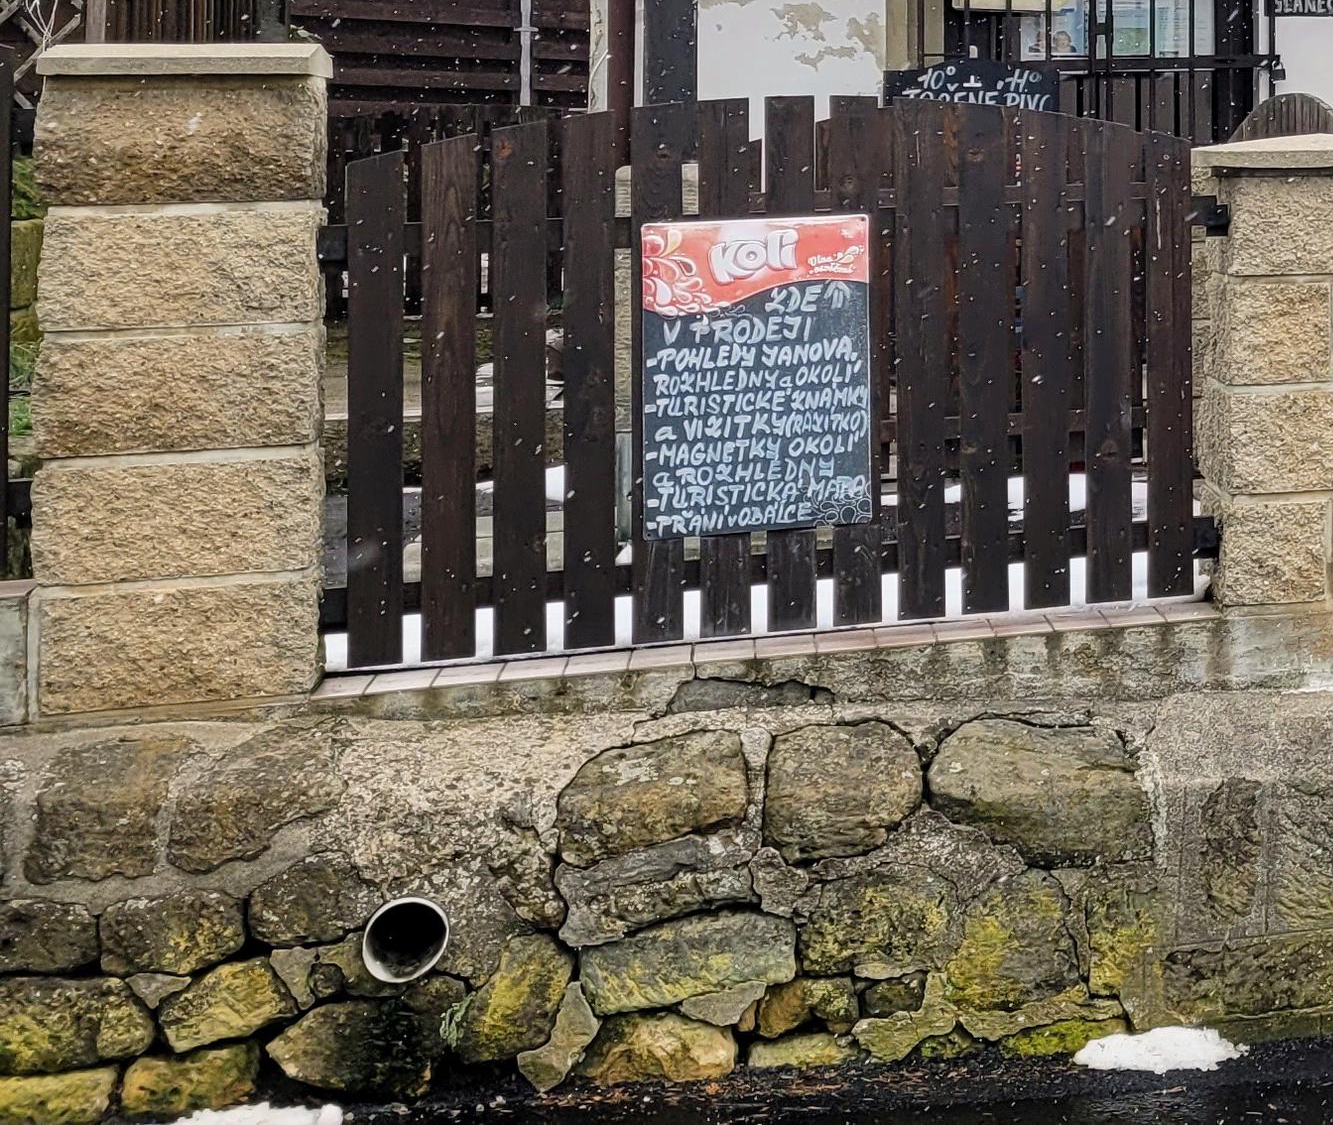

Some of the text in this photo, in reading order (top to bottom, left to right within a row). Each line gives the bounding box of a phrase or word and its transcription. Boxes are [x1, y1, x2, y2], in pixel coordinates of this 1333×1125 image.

[765, 284, 822, 313] ZDE
[663, 320, 681, 346] V
[653, 368, 776, 396] ROZHLEDNY
[655, 426, 678, 442] a
[683, 412, 787, 441] VIZITKY
[652, 458, 835, 487] a ROZHLEDNY
